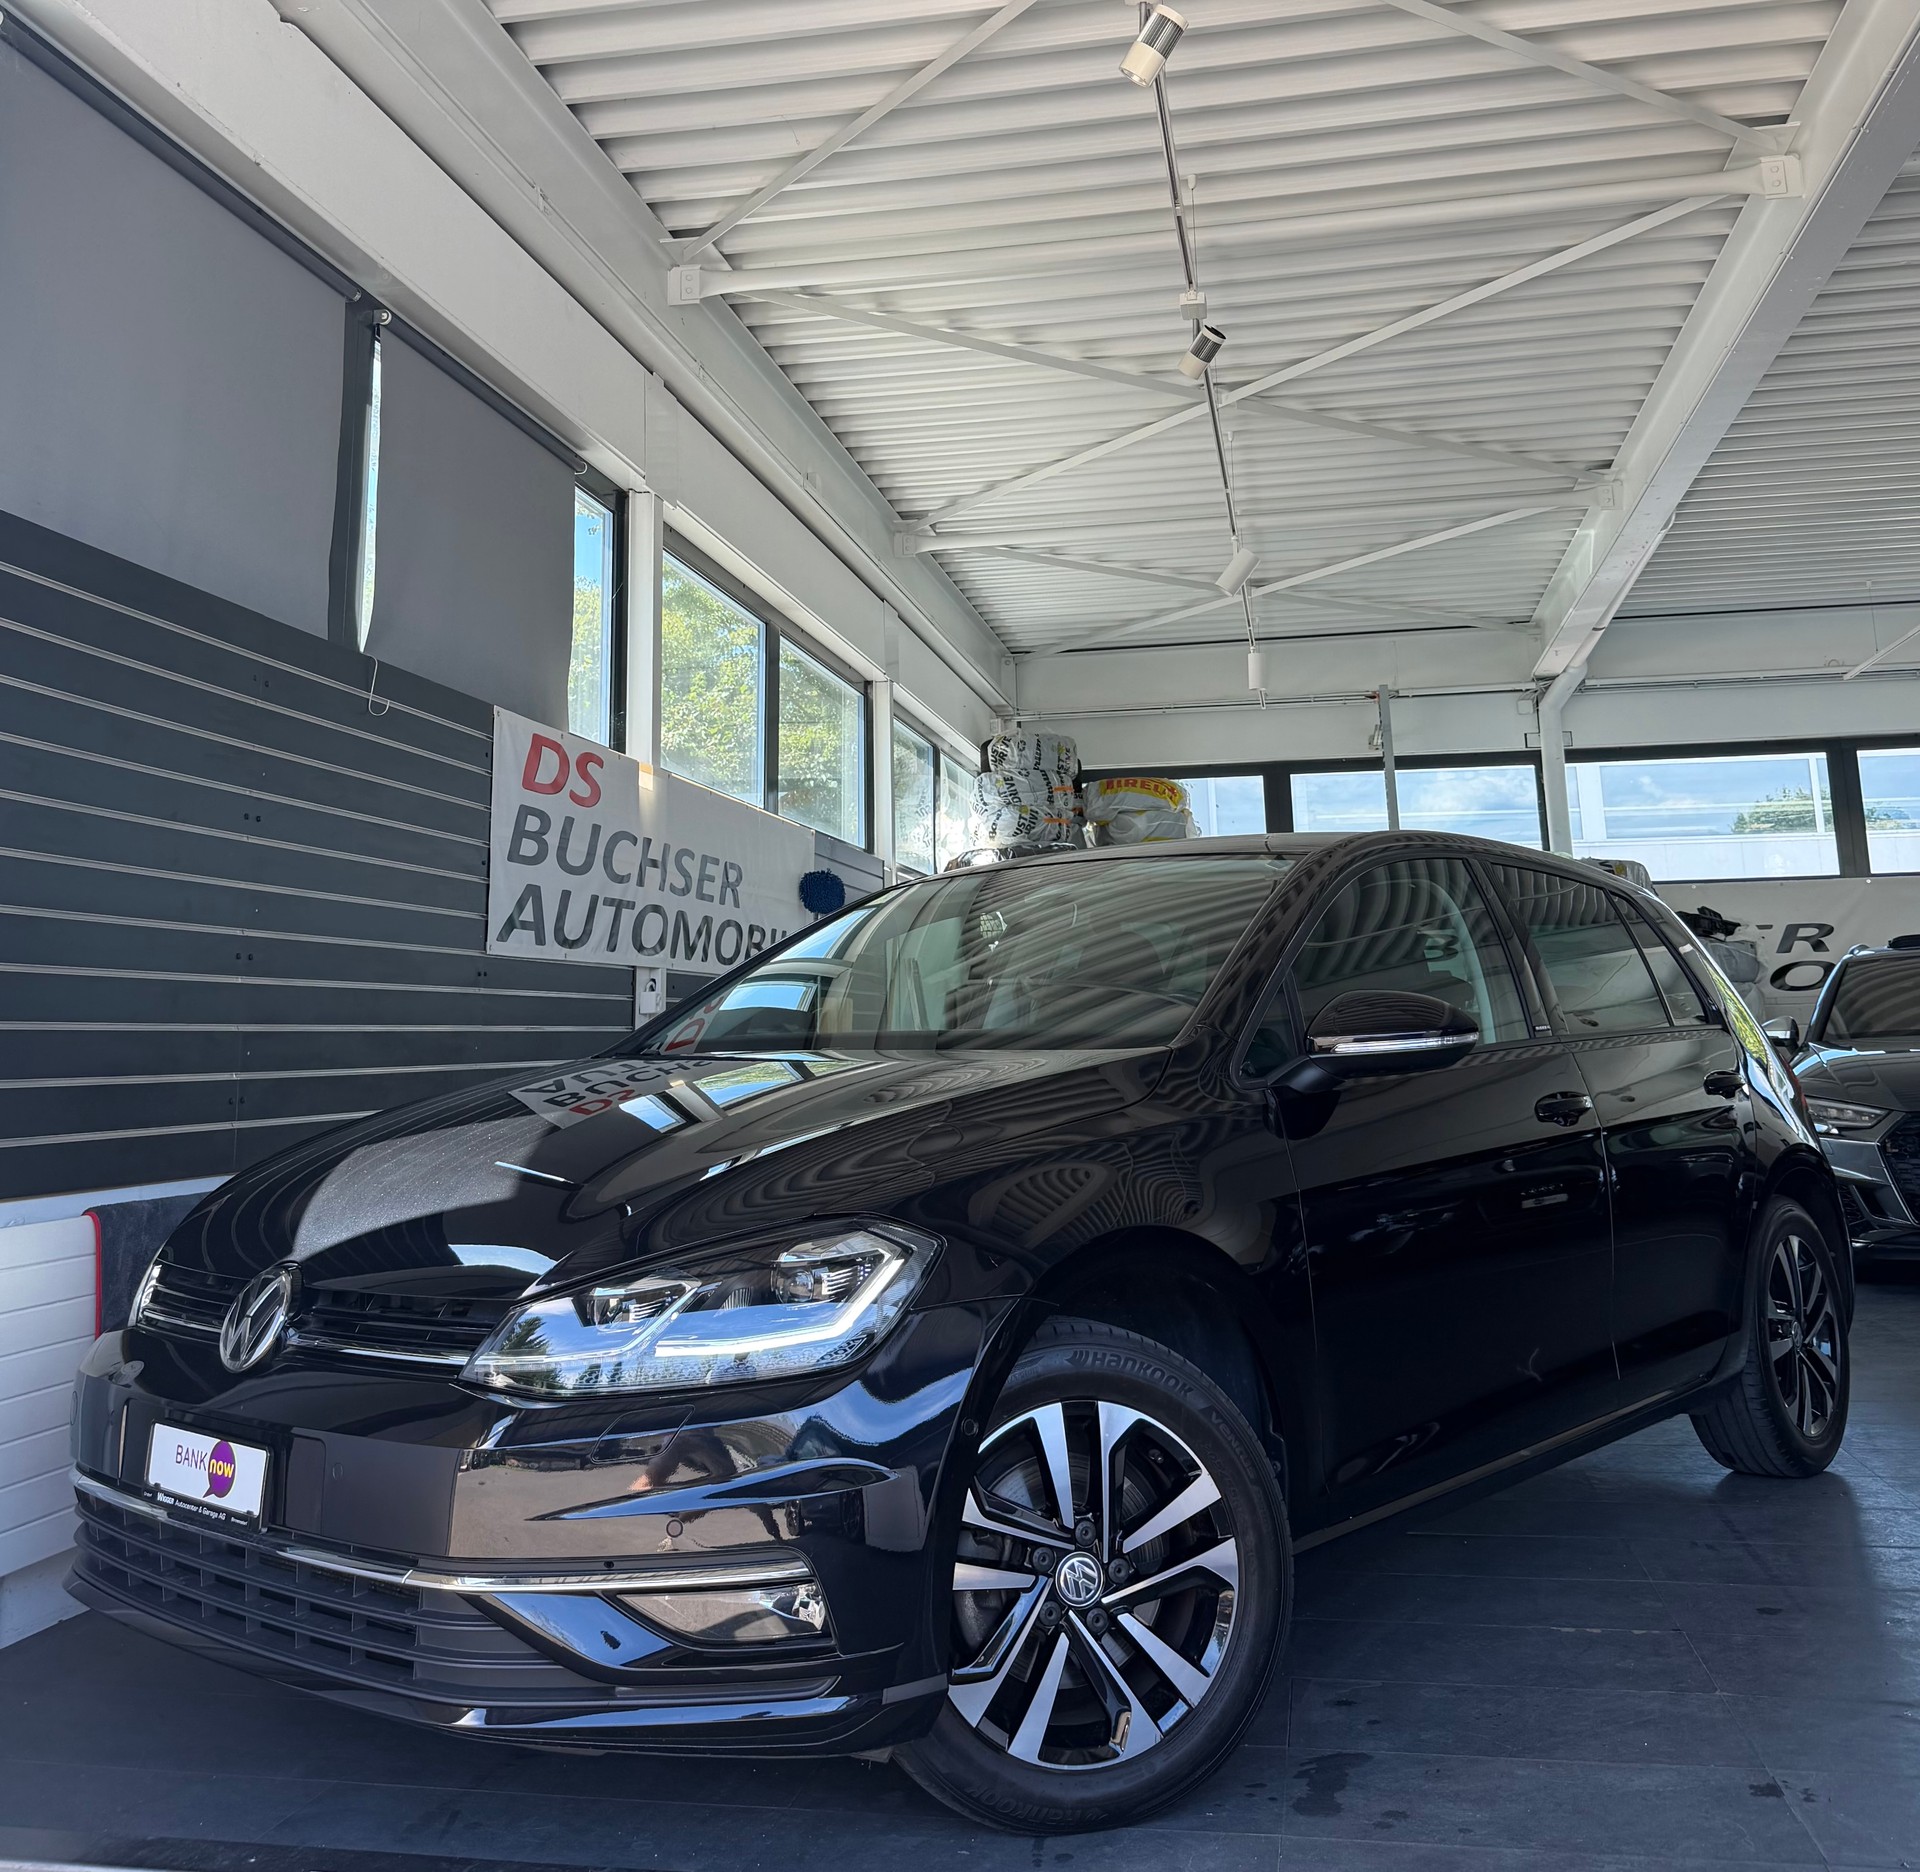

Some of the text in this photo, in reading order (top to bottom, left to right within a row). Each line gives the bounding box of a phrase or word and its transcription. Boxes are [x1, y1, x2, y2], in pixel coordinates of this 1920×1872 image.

[521, 733, 604, 808] DS
[507, 804, 743, 909] BUCHSER
[175, 1444, 208, 1472] BANK
[209, 1458, 235, 1478] now
